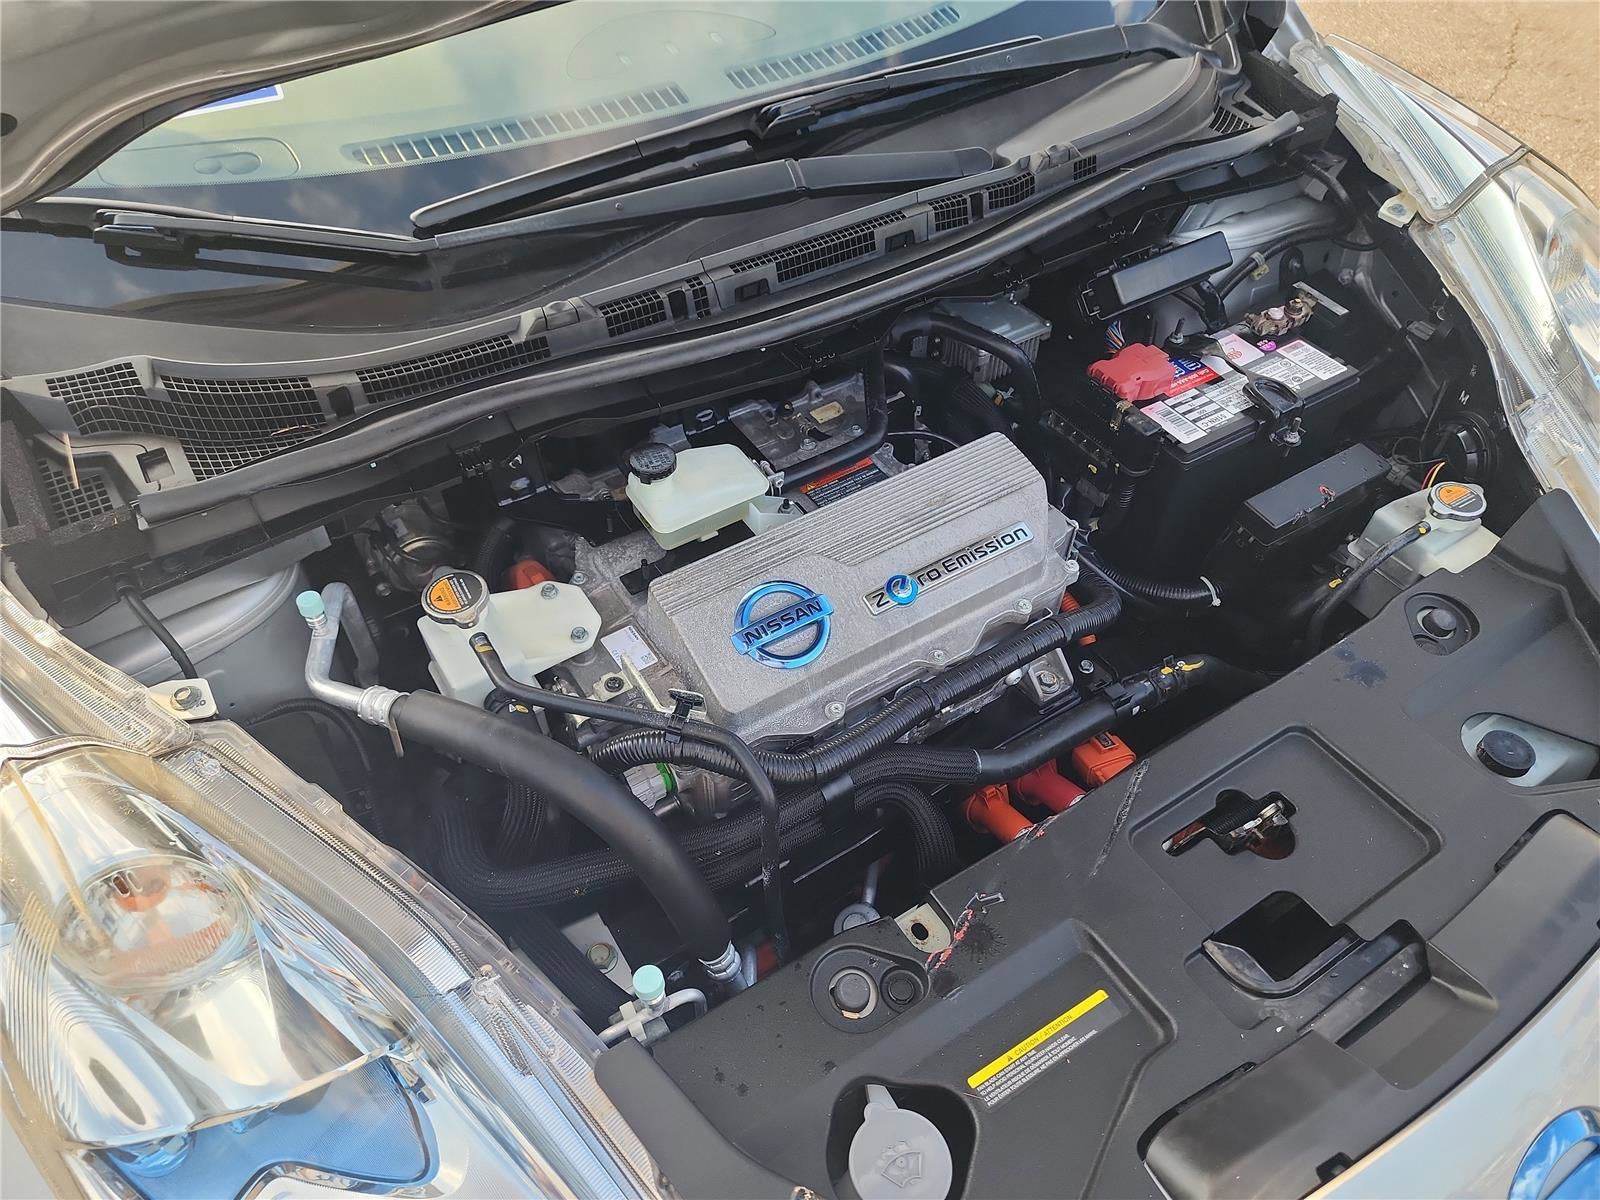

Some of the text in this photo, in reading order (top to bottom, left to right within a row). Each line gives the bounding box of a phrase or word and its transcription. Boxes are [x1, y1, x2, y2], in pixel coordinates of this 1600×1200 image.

[941, 526, 1030, 574] Emission
[744, 599, 824, 645] NISSAN
[1015, 1037, 1039, 1054] CAUTION
[1043, 1014, 1072, 1036] ATTENTION
[985, 1083, 996, 1092] HELP
